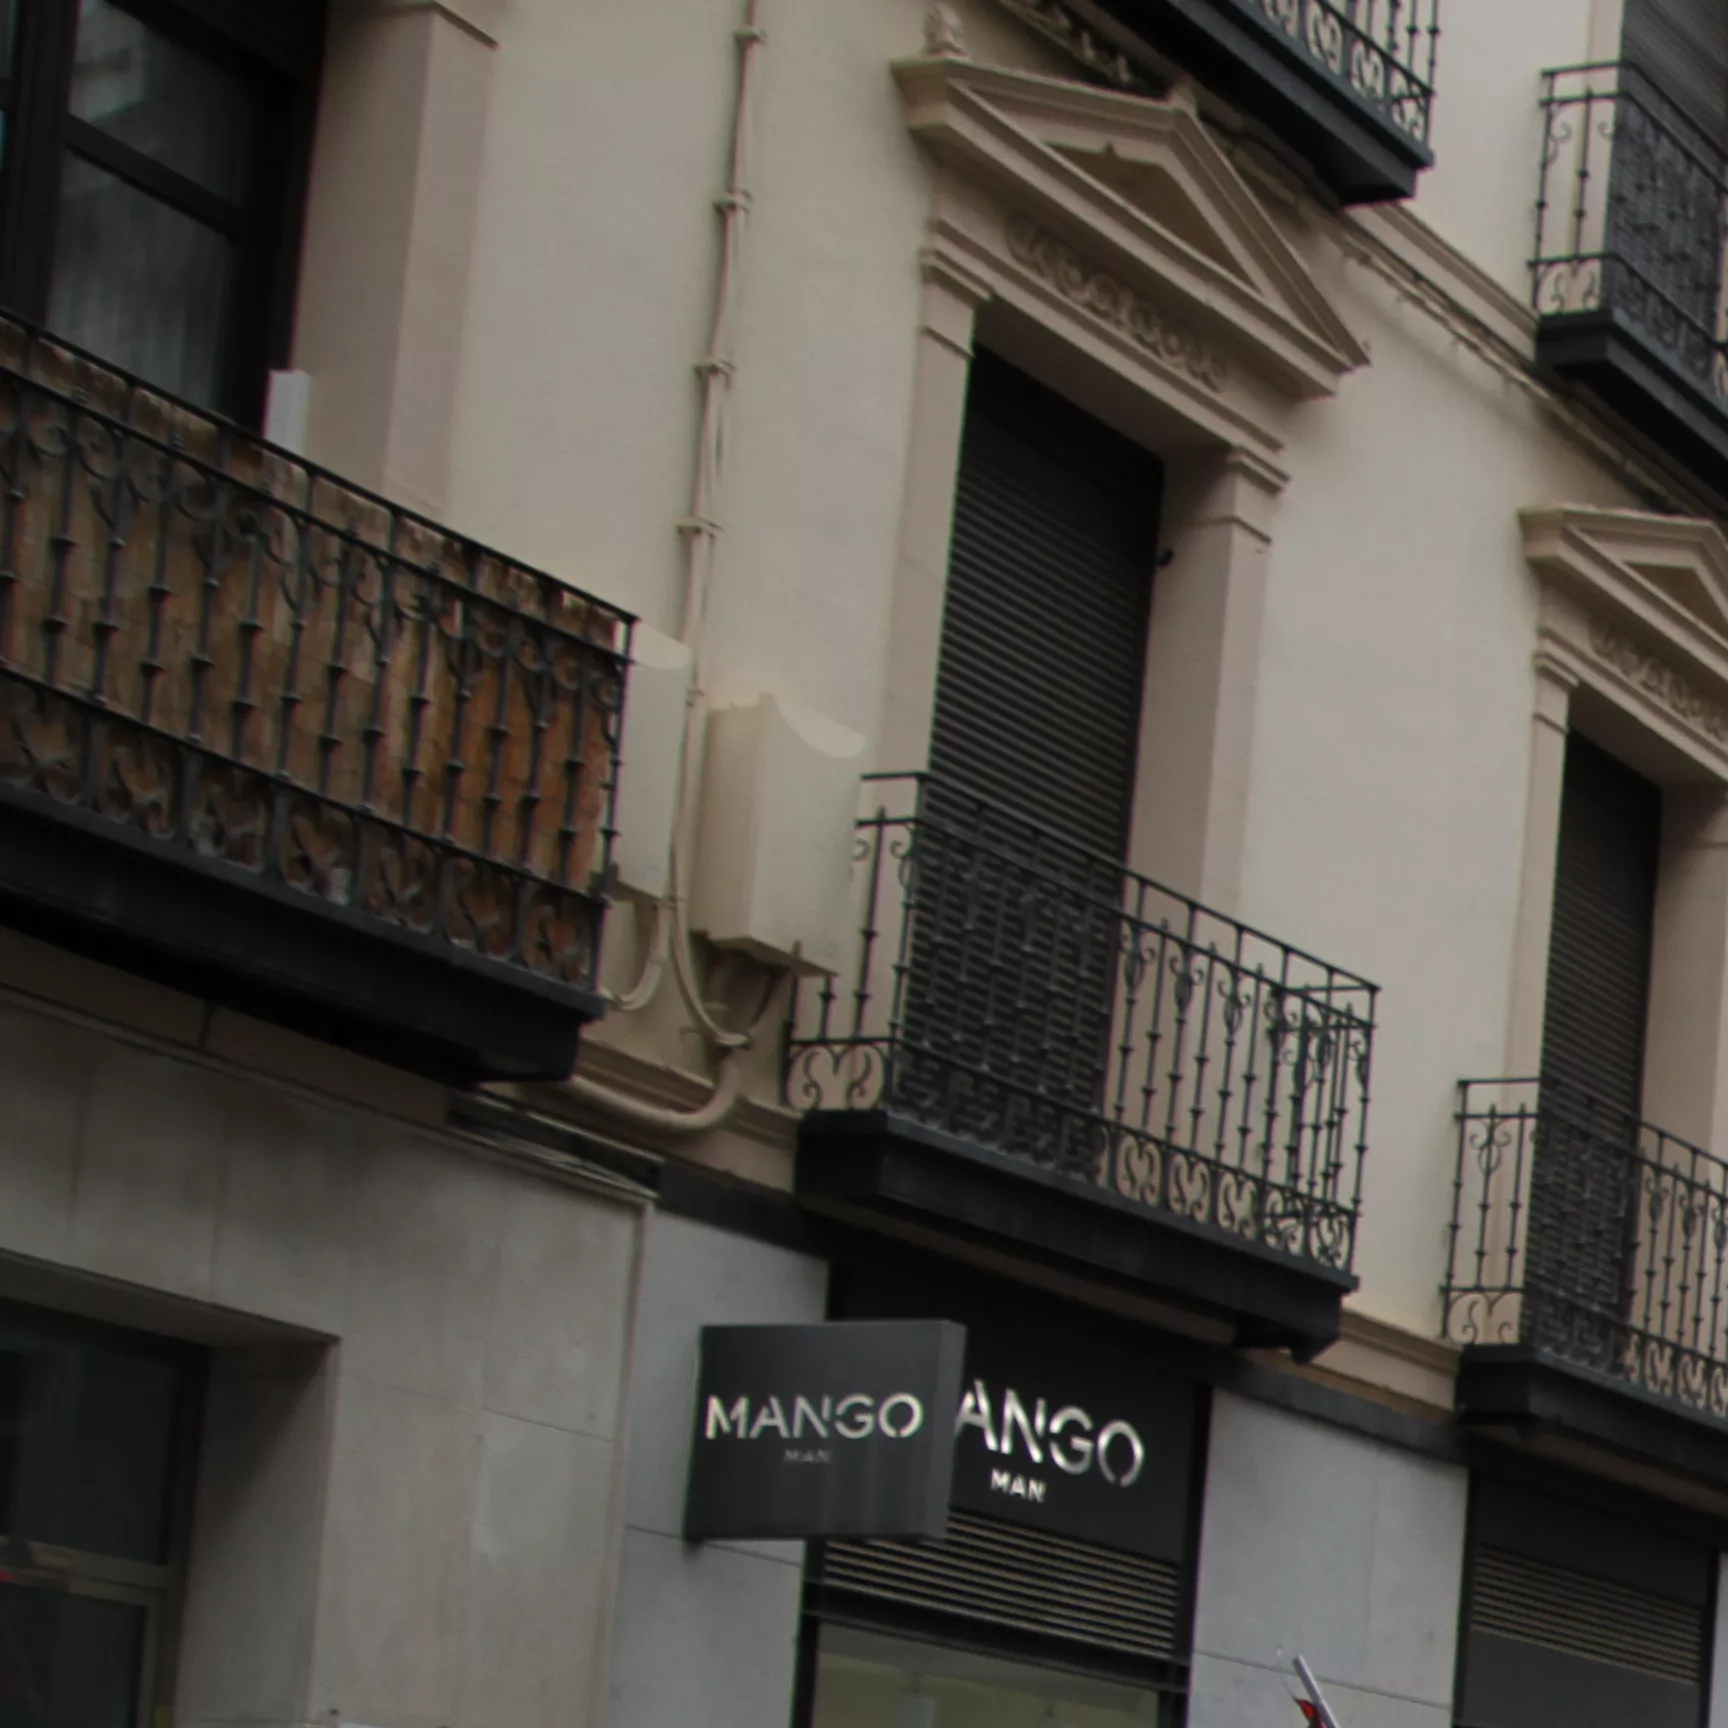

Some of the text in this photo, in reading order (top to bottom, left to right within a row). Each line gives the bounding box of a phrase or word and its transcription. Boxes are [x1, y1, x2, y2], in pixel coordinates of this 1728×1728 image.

[705, 1393, 924, 1439] MANGO
[955, 1378, 1146, 1488] ANGO
[990, 1467, 1047, 1503] MAN
